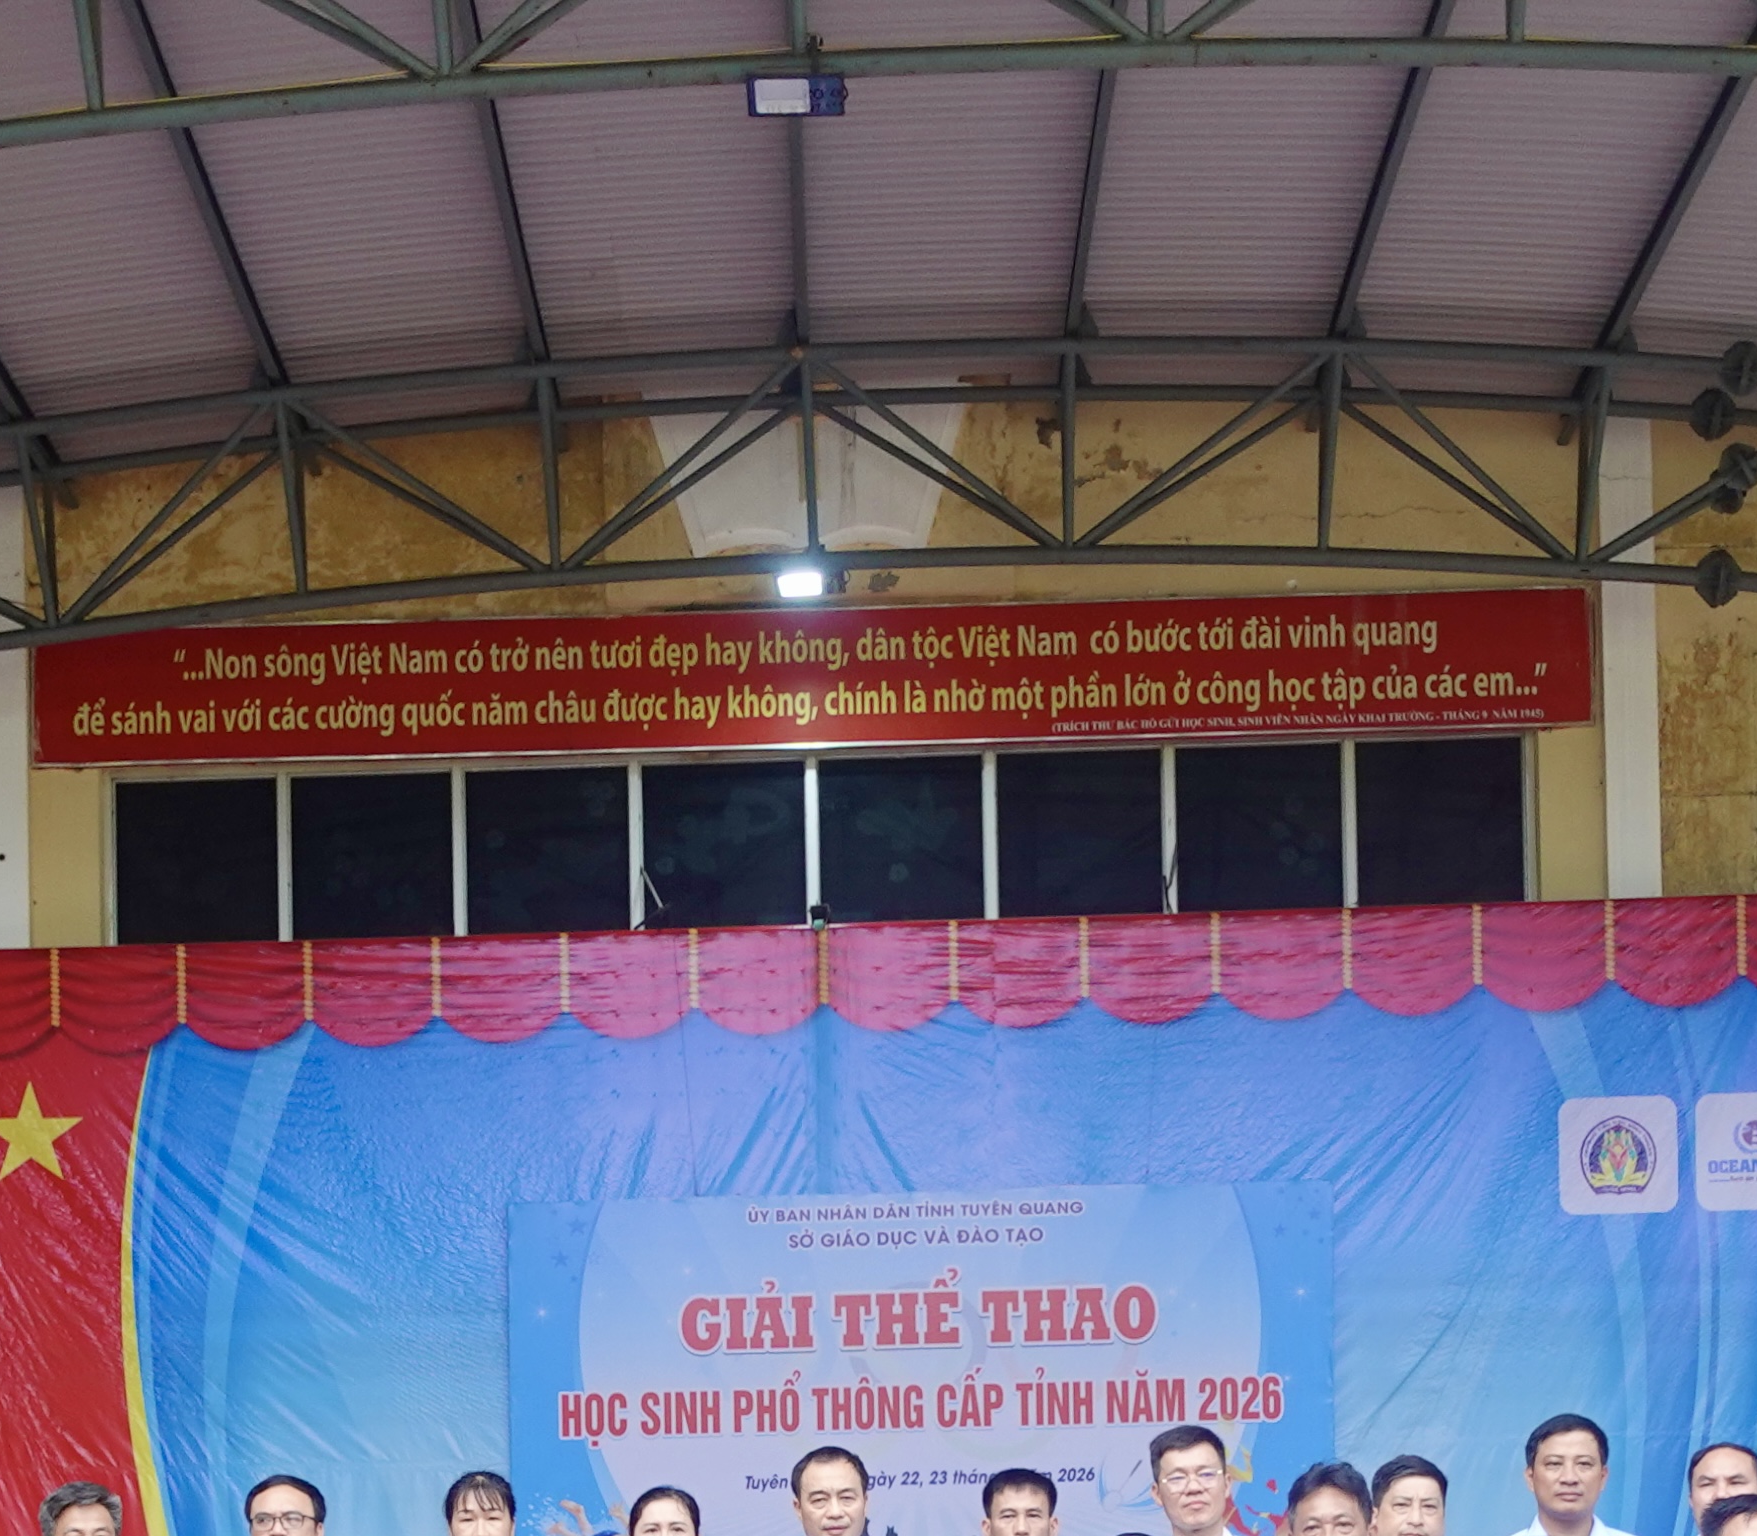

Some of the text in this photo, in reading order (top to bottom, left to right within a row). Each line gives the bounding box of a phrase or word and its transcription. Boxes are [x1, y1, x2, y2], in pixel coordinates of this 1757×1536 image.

[264, 645, 325, 685] sông
[331, 643, 382, 684] Việt
[390, 643, 447, 674] Nam
[455, 640, 483, 673] có
[490, 637, 529, 672] trở
[536, 638, 583, 670] nên
[590, 636, 641, 669] tươi
[649, 634, 698, 676] đẹp
[706, 633, 752, 673] hay
[759, 629, 849, 670] không,
[856, 628, 906, 661] dân
[912, 627, 953, 668] tộc
[958, 625, 1010, 666] Việt
[1018, 625, 1076, 656] Nam
[1090, 621, 1119, 654] có
[1127, 619, 1191, 652] bước
[1197, 618, 1233, 650] tới
[1241, 616, 1280, 649] đài
[1288, 614, 1345, 648] vinh
[1353, 621, 1437, 655] quang
[73, 698, 105, 735] để
[111, 701, 171, 735] sánh
[178, 700, 215, 733] vai
[222, 699, 261, 732] với
[268, 697, 309, 730] các
[315, 696, 394, 736] cường
[402, 689, 465, 735] quốc
[472, 694, 527, 725] năm
[535, 691, 596, 724] châu
[603, 689, 667, 730] được
[675, 687, 721, 729] hay
[728, 685, 818, 726] không,
[824, 681, 896, 716] chính
[904, 681, 926, 713] là
[934, 679, 986, 712] nhờ
[992, 678, 1044, 719] một
[1051, 671, 1117, 717] phần
[1125, 674, 1166, 706] lớn
[1173, 670, 1191, 705] ở
[1197, 671, 1260, 712] công
[1269, 669, 1315, 711] học
[1321, 668, 1365, 710] tập
[1372, 664, 1417, 699] của
[1425, 665, 1467, 698] các
[748, 1200, 1084, 1223] ỦY BAN NHÂN DÂN TỈNH TUYÊN QUANG
[789, 1225, 1044, 1250] SỞ GIÁO DỤC VÀ ĐÀO TẠO
[680, 1269, 1157, 1352] GIẢI THỂ THAO
[561, 1367, 1283, 1446] HỌC SINH PHỔ THÔNG CẤP TỈNH NĂM 2026
[745, 1474, 788, 1492] Tuyên
[867, 1471, 896, 1490] gày
[900, 1471, 924, 1488] 22,
[929, 1470, 948, 1485] 23
[953, 1468, 992, 1485] thán
[1057, 1467, 1095, 1482] 2026
